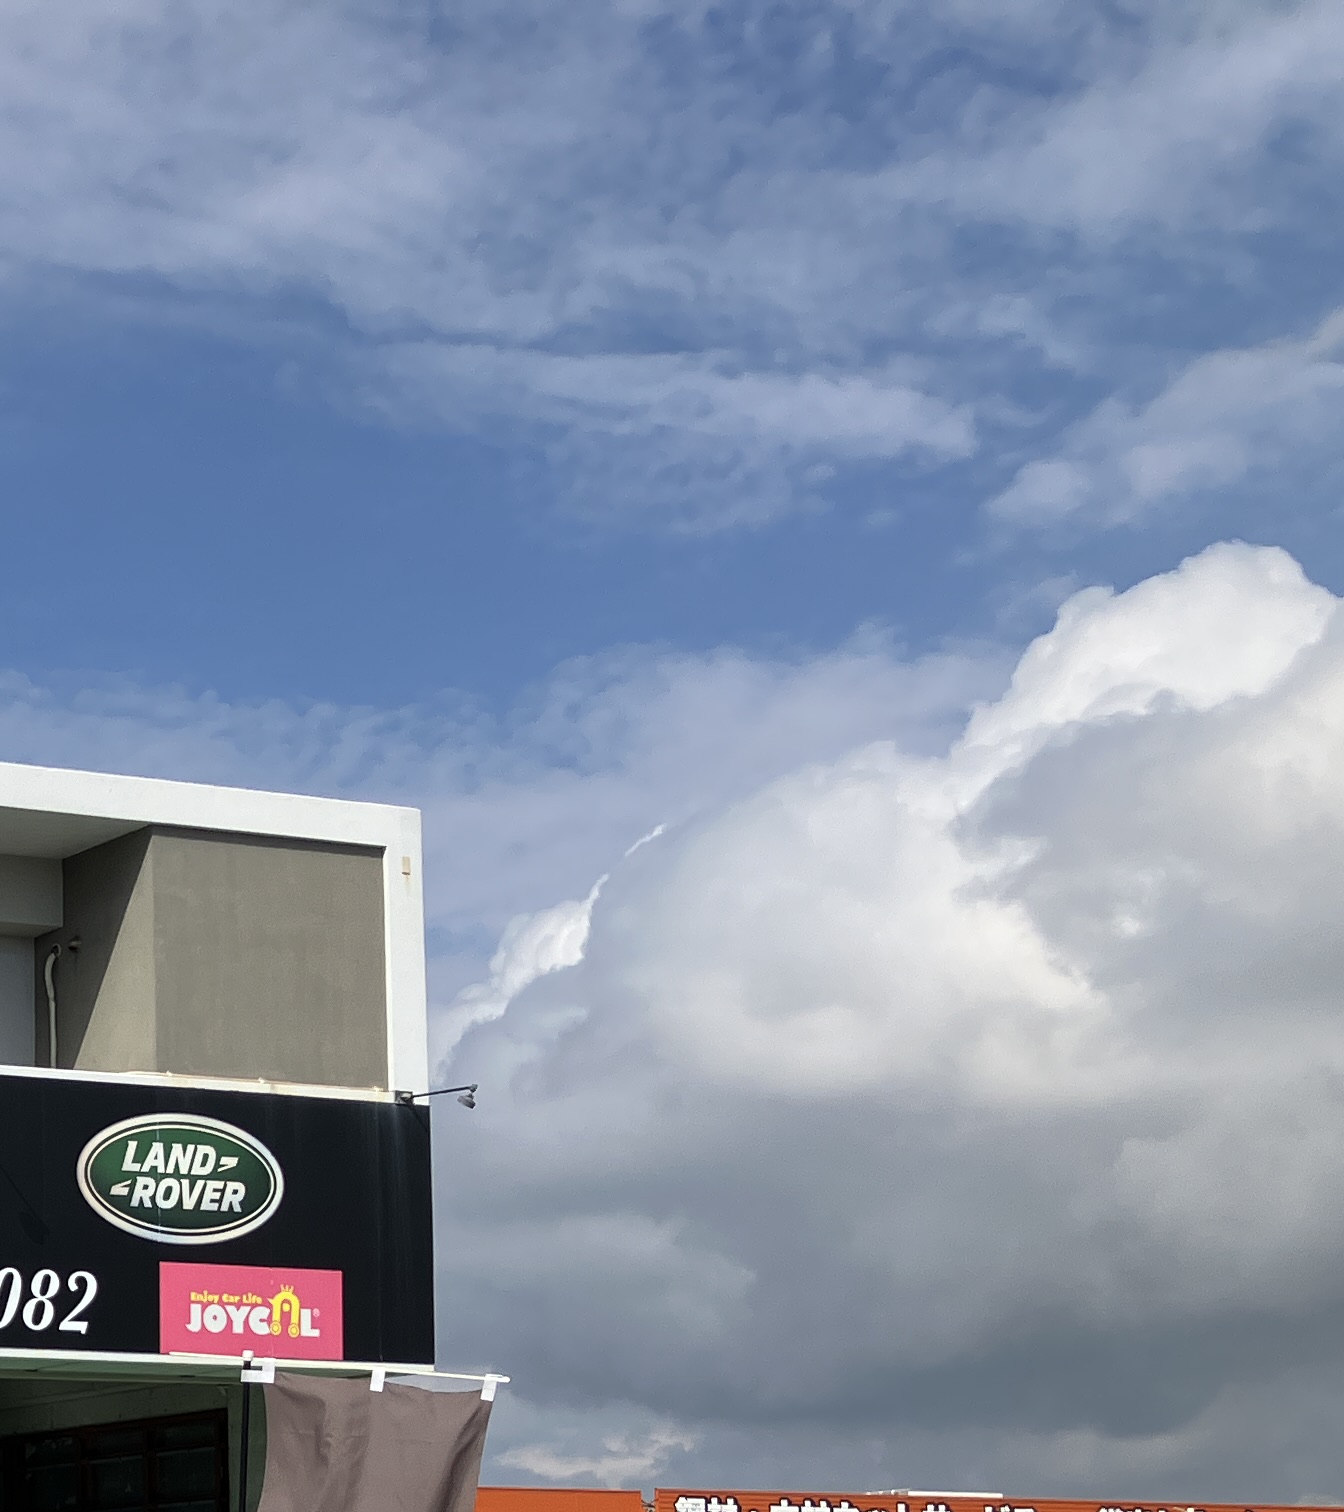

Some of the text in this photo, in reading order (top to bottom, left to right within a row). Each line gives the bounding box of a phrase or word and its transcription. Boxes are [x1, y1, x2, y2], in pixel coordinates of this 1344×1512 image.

[121, 1140, 217, 1176] LAND
[130, 1176, 246, 1213] ROVER
[190, 1290, 263, 1304] Enjoy Car Life
